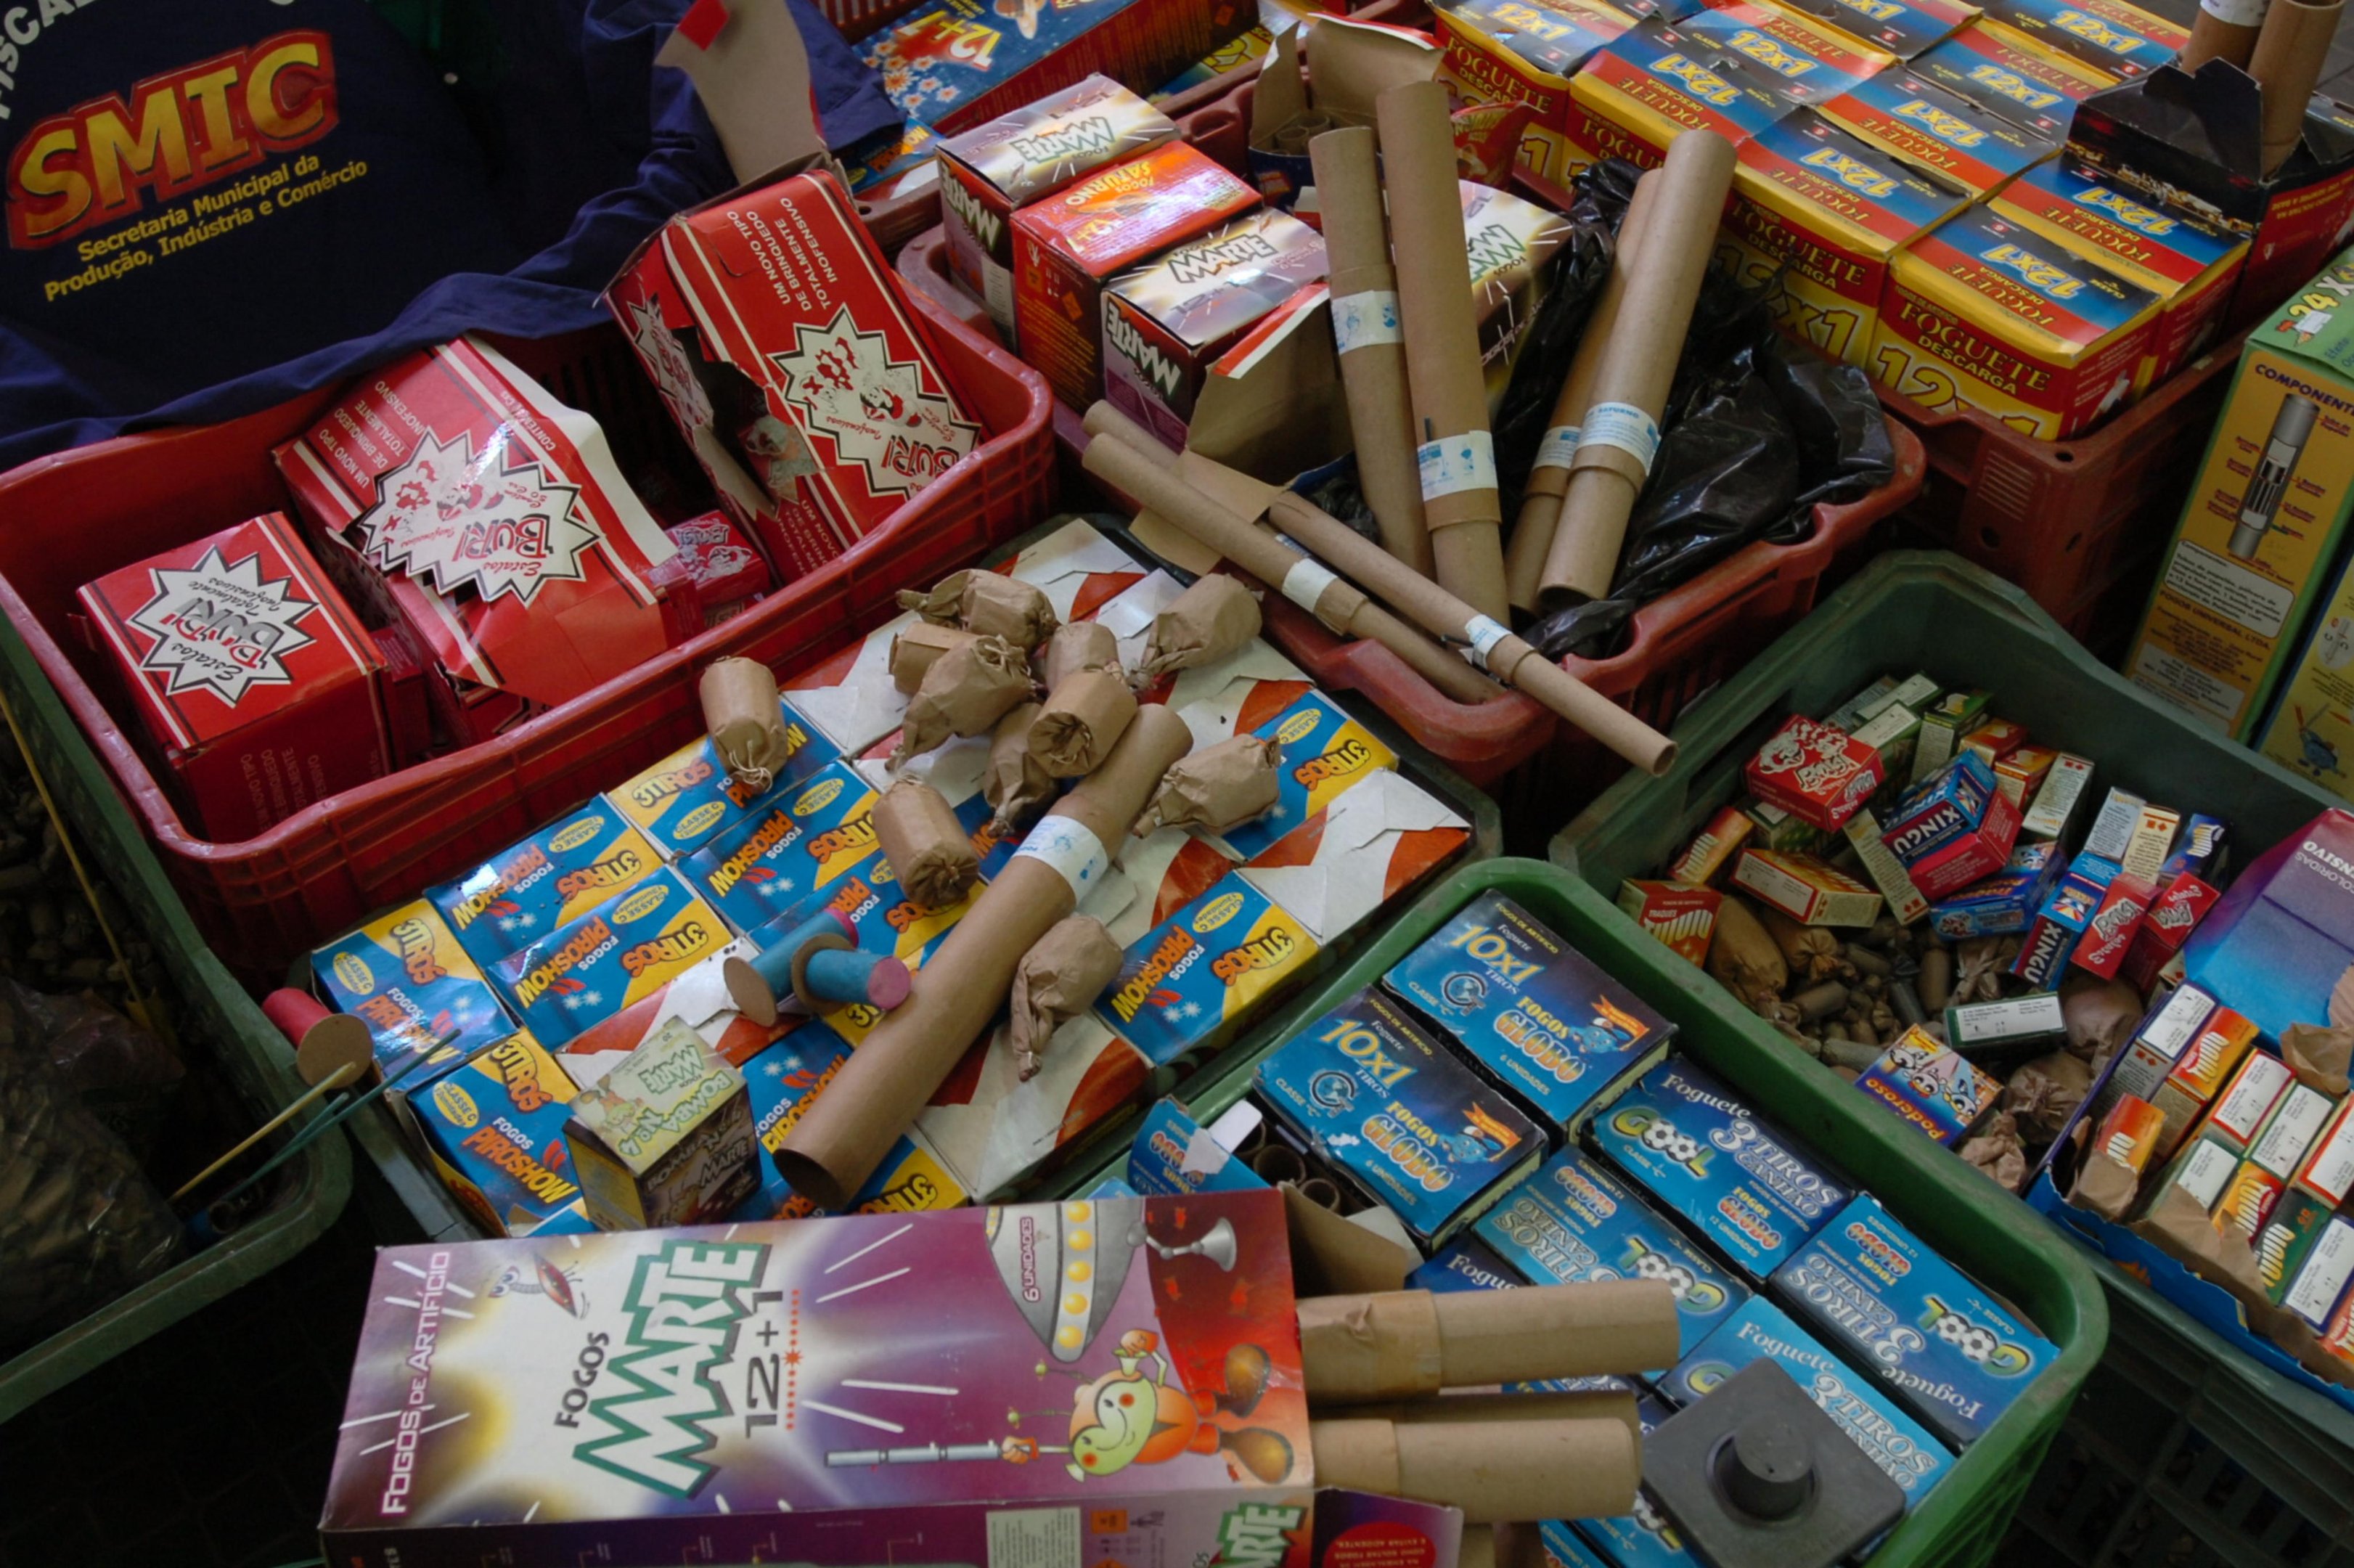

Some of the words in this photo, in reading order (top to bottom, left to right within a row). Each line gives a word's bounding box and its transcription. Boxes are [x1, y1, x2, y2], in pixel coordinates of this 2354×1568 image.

[1489, 2, 1575, 41] 12x1
[1757, 12, 1850, 60] FOGUETE
[1762, 25, 1820, 57] DESCARGA
[2050, 9, 2149, 54] 12x1
[1447, 38, 1554, 114] FOGUETE
[1727, 29, 1818, 78] 12x1
[1618, 77, 1713, 130] FOGUETE
[1647, 78, 1704, 113] DESCARGA
[1649, 53, 1742, 106] 12x1
[1968, 64, 2064, 108] 12x1
[12, 33, 332, 243] SMIC
[1010, 116, 1118, 163] MARTE
[1859, 116, 1959, 170] FOGUETE
[1889, 120, 1950, 152] DESCARGA
[1892, 99, 1990, 147] 12x1
[1066, 160, 1151, 206] SATURNO
[1115, 175, 1155, 193] FOGOS
[1769, 168, 1870, 222] FOGUETE
[1799, 147, 1900, 197] 12x1
[1799, 169, 1861, 203] DESCARGA
[44, 250, 154, 301] Produção,
[157, 208, 254, 258] Indústria
[259, 199, 274, 216] e
[277, 158, 368, 208] Comércio
[77, 208, 189, 262] Secretaria
[193, 164, 289, 217] Municipal
[294, 153, 319, 176] da
[727, 211, 752, 241] TIPO
[2072, 186, 2178, 236] 12x1
[2073, 207, 2141, 242] DESCARGA
[746, 211, 800, 293] BRINQUEDO
[780, 197, 838, 282] INOFENSIVO
[1166, 232, 1280, 284] MARTE
[2041, 205, 2154, 265] FOGUETE
[749, 240, 782, 285] NOVO
[774, 219, 831, 310] TOTALMENTE
[1977, 264, 2046, 305] DESCARGA
[1979, 243, 2088, 300] 12x1
[772, 285, 793, 305] UM
[792, 293, 812, 311] DE
[1945, 261, 2059, 327] FOGUETE
[1106, 303, 1182, 399] MARTE
[1898, 301, 2052, 393] FOGUETE
[1917, 335, 2018, 396] DESCARGA
[333, 407, 375, 456] BRINQUEDO
[353, 399, 406, 457] TOTALMENTE
[374, 380, 427, 436] INOFENSIVO
[825, 414, 881, 441] Inofensivos
[318, 428, 338, 453] TIPO
[335, 446, 358, 475] NOVO
[372, 451, 389, 468] DE
[353, 467, 370, 489] UM
[451, 513, 555, 563] BURI
[208, 576, 281, 612] Inofensivos
[482, 560, 544, 578] Estalos
[188, 581, 261, 618] Totalmente
[161, 596, 286, 670] BURI
[171, 642, 244, 682] Estalos
[632, 759, 713, 808] 3TIROS
[1293, 738, 1371, 791] 3TIROS
[708, 809, 796, 898] PIROSHOW
[766, 827, 803, 860] FOGOS
[1892, 805, 1963, 857] XINGU
[515, 862, 556, 894] FOGOS
[557, 849, 642, 902] 3TIROS
[1208, 899, 1245, 927] CLASSE
[1495, 902, 1520, 923] FOGOS
[1525, 923, 1559, 955] ARTIFICIO
[1497, 923, 1533, 953] Foguete
[394, 918, 449, 986] 3TIROS
[514, 916, 613, 1011] PIROSHOW
[579, 935, 619, 972] FOGOS
[619, 921, 710, 976] 3TIROS
[1169, 944, 1206, 982] FOGOS
[1211, 926, 1296, 987] 3TIROS
[1450, 925, 1545, 986] 10x1
[2022, 922, 2064, 985] XINGU
[1110, 925, 1197, 1024] PIROSHOW
[1407, 980, 1442, 1008] CLASSE
[1484, 966, 1521, 995] TIROS
[387, 987, 425, 1021] FOGOS
[1515, 995, 1571, 1040] FOGOS
[1317, 1017, 1418, 1089] 10x1
[1370, 1019, 1407, 1053] Foguete
[1493, 1009, 1586, 1084] GLOBO
[492, 1039, 555, 1116] 3TIROS
[638, 1045, 705, 1095] MARTE
[1274, 1077, 1308, 1107] CLASSE
[1353, 1066, 1391, 1098] TIROS
[1507, 1059, 1552, 1096] UNIDADES
[444, 1082, 472, 1117] CLASSE
[662, 1070, 734, 1132] BOMBA
[754, 1098, 792, 1138] FOGOS
[1662, 1074, 1752, 1119] Foguete
[492, 1116, 534, 1151] FOGOS
[1384, 1099, 1440, 1148] FOGOS
[461, 1124, 579, 1205] PIROSHOW
[698, 1137, 750, 1188] MARTE
[1361, 1111, 1455, 1193] GLOBO
[1623, 1144, 1654, 1169] CLASSE
[1710, 1118, 1758, 1153] 3
[1750, 1132, 1842, 1206] TIROS
[1554, 1165, 1618, 1219] GLOBO
[1732, 1185, 1771, 1217] FOGOS
[1736, 1152, 1822, 1219] CANHÃO
[1513, 1196, 1598, 1267] CANHÃO
[1565, 1196, 1603, 1228] FOGOS
[1717, 1194, 1783, 1250] GLOBO
[1866, 1214, 1909, 1251] UNIDADES
[1019, 1217, 1036, 1288] UNIDADES
[1716, 1220, 1760, 1258] UNIDADES
[1845, 1221, 1912, 1278] GLOBO
[1807, 1254, 1897, 1326] CANHÃO
[1856, 1252, 1897, 1287] FOGOS
[1022, 1287, 1040, 1303] 6
[1788, 1268, 1885, 1350] TIROS
[1736, 1320, 1835, 1374] Foguete
[1873, 1326, 1925, 1365] 3
[1984, 1308, 2016, 1336] CLASSE
[554, 1331, 610, 1429] FOGOS
[573, 1239, 772, 1499] MARTE
[745, 1289, 783, 1439] 12+1
[1881, 1363, 1983, 1420] Foguete
[382, 1402, 424, 1515] FOGOS
[410, 1376, 428, 1406] DE
[1836, 1391, 1940, 1477] TIROS
